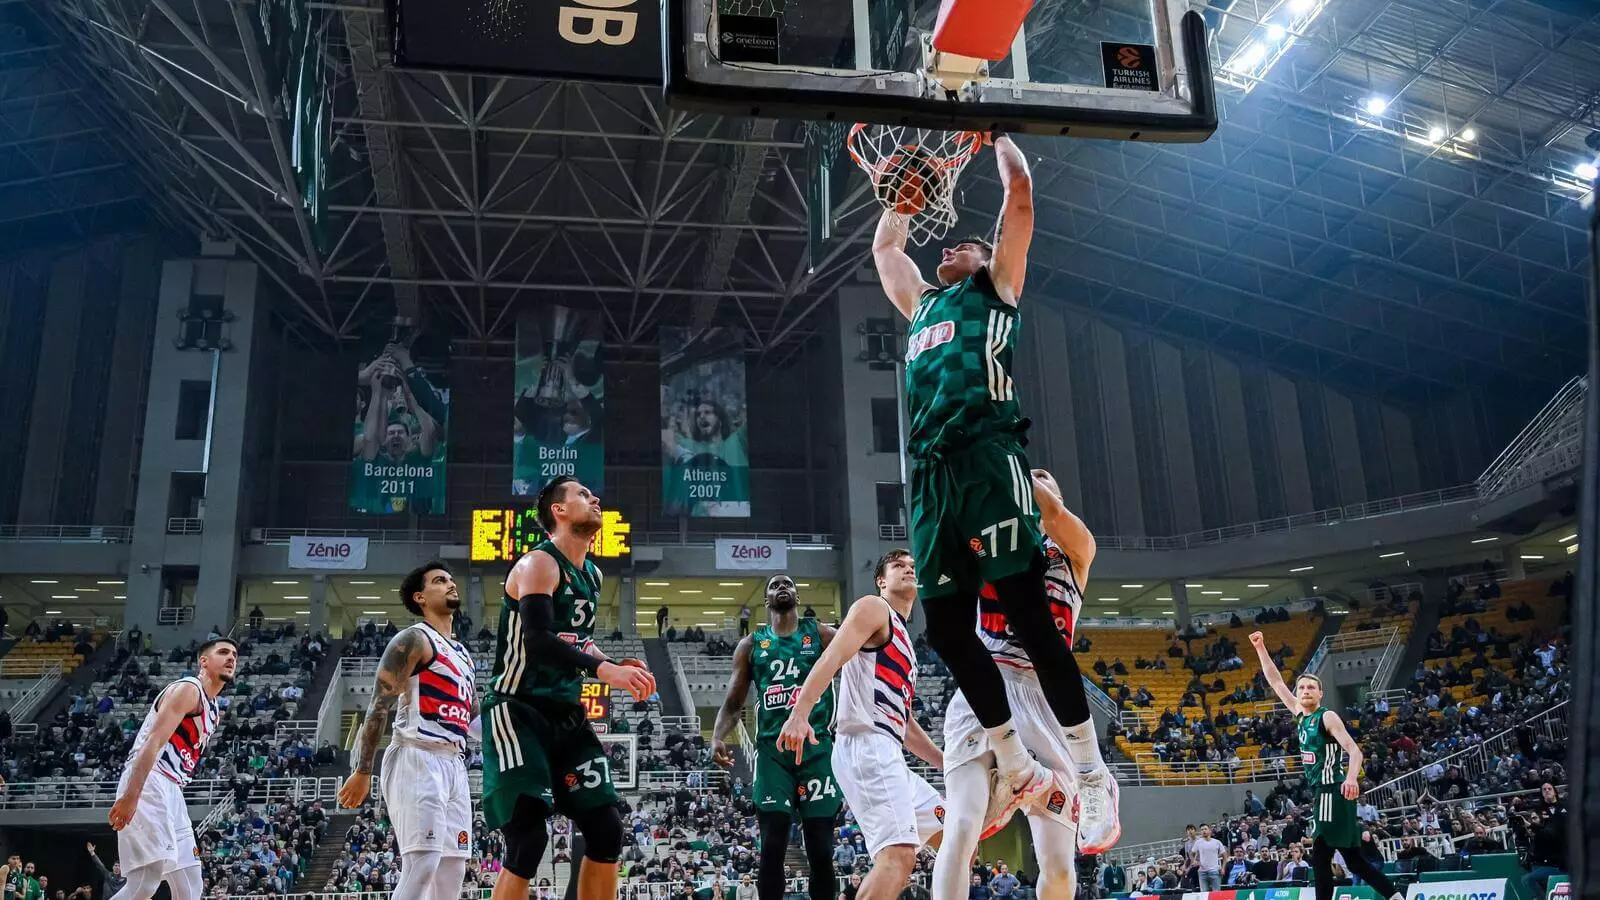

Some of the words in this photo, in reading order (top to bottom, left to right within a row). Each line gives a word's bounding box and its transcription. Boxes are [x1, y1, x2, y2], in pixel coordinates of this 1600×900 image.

[1112, 68, 1150, 78] TURKISH
[1113, 75, 1151, 85] AIRLINES
[539, 446, 578, 460] Berlin
[364, 462, 433, 477] Barcelona
[541, 462, 575, 476] 2009
[683, 468, 727, 482] Athens
[380, 480, 415, 494] 2011
[689, 484, 721, 498] 2007
[981, 517, 1019, 558] 77
[571, 599, 596, 628] 37
[770, 657, 800, 681] 24
[438, 703, 471, 724] CAZO
[575, 756, 610, 789] 37
[807, 775, 837, 802] 24
